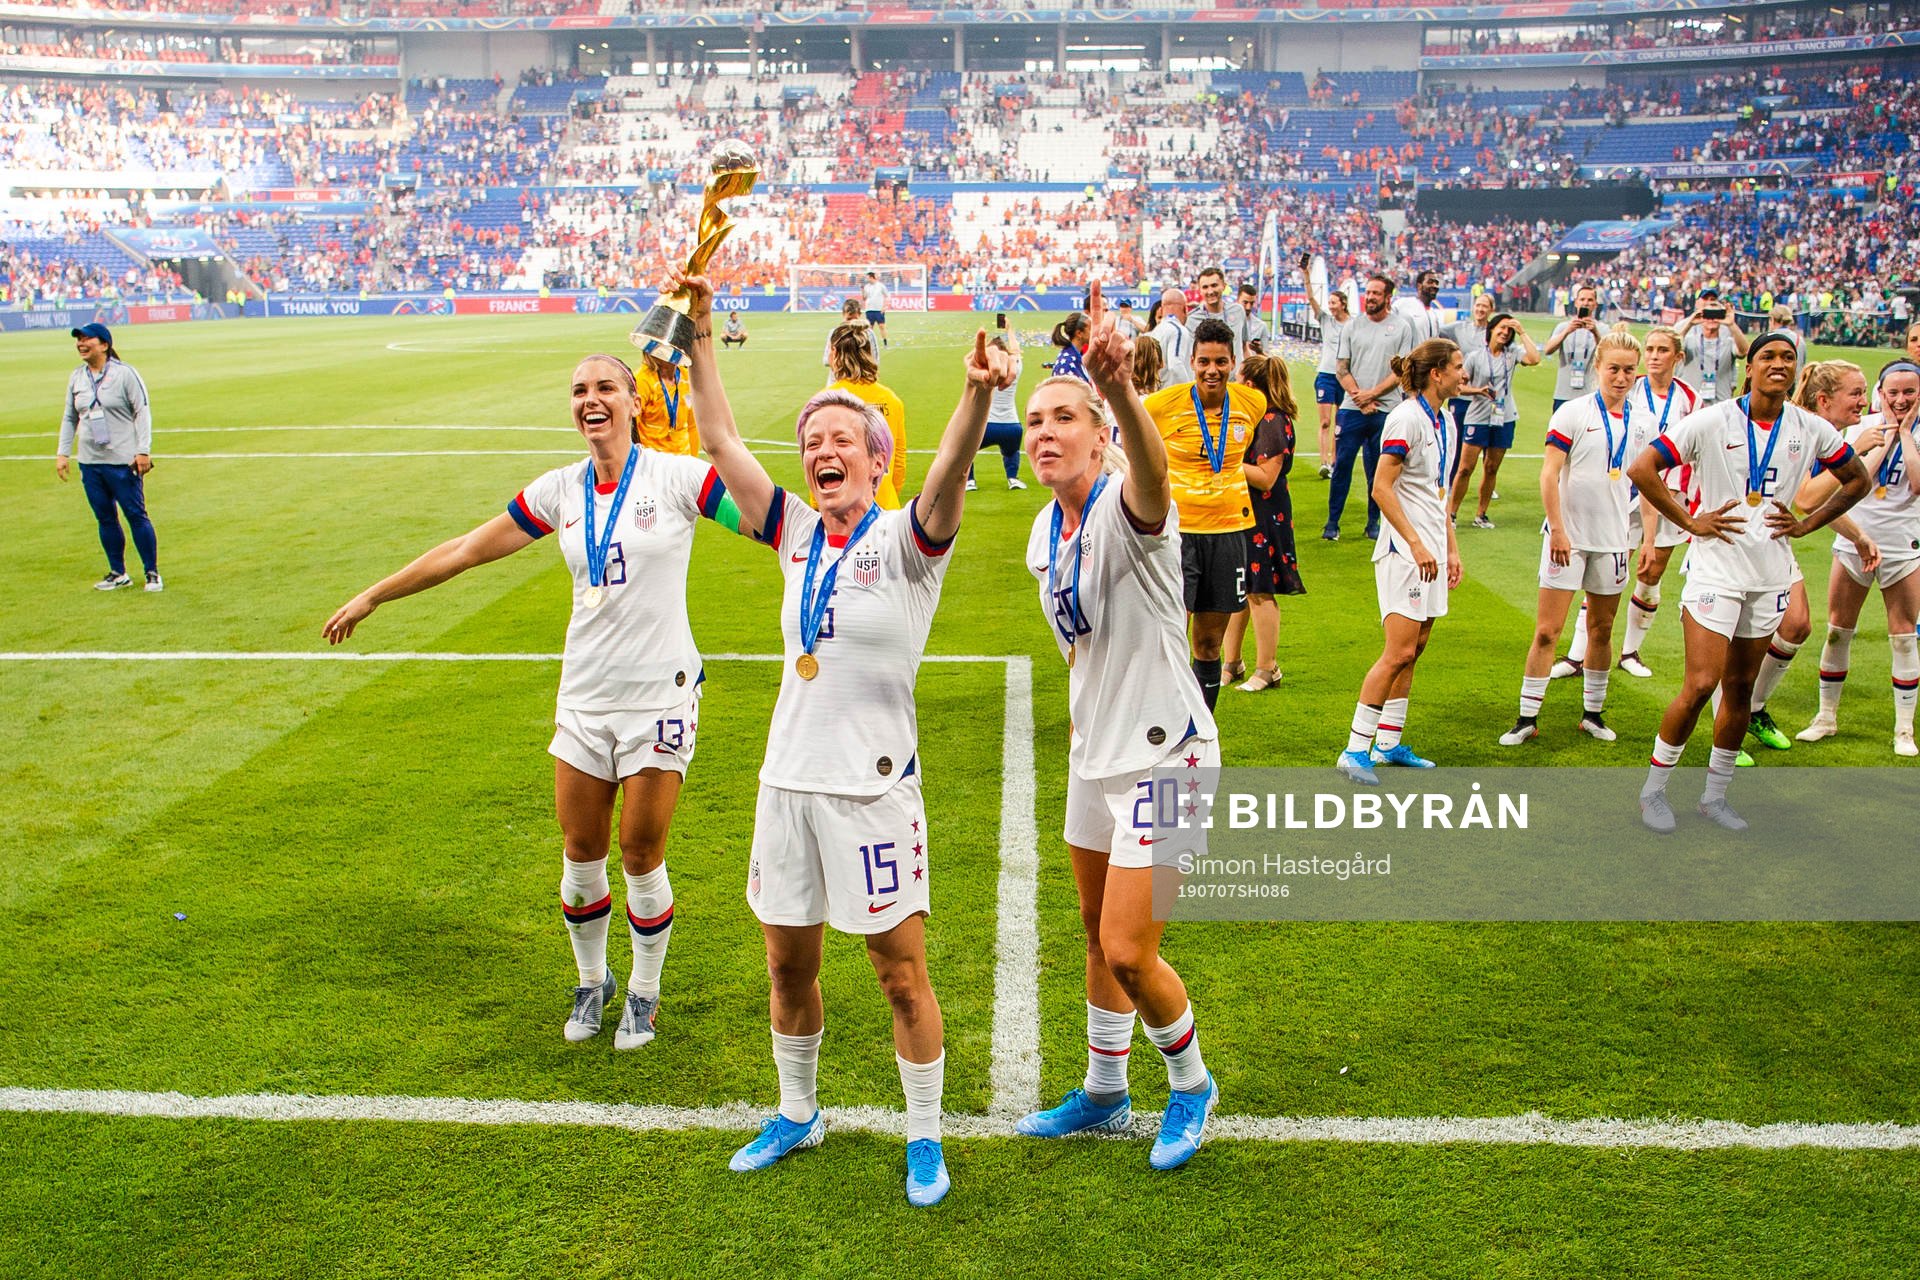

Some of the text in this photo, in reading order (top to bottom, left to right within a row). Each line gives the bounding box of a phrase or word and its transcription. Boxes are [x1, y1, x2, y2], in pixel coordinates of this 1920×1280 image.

[1794, 41, 1826, 50] FRANCE
[281, 301, 360, 314] THANK YOU
[489, 300, 540, 312] FRANCE
[721, 297, 750, 310] YOU
[889, 297, 936, 309] RANCE
[636, 506, 654, 518] USA
[856, 560, 878, 571] USA
[656, 718, 684, 751] 13
[1133, 778, 1178, 828] 20
[859, 842, 899, 895] 15
